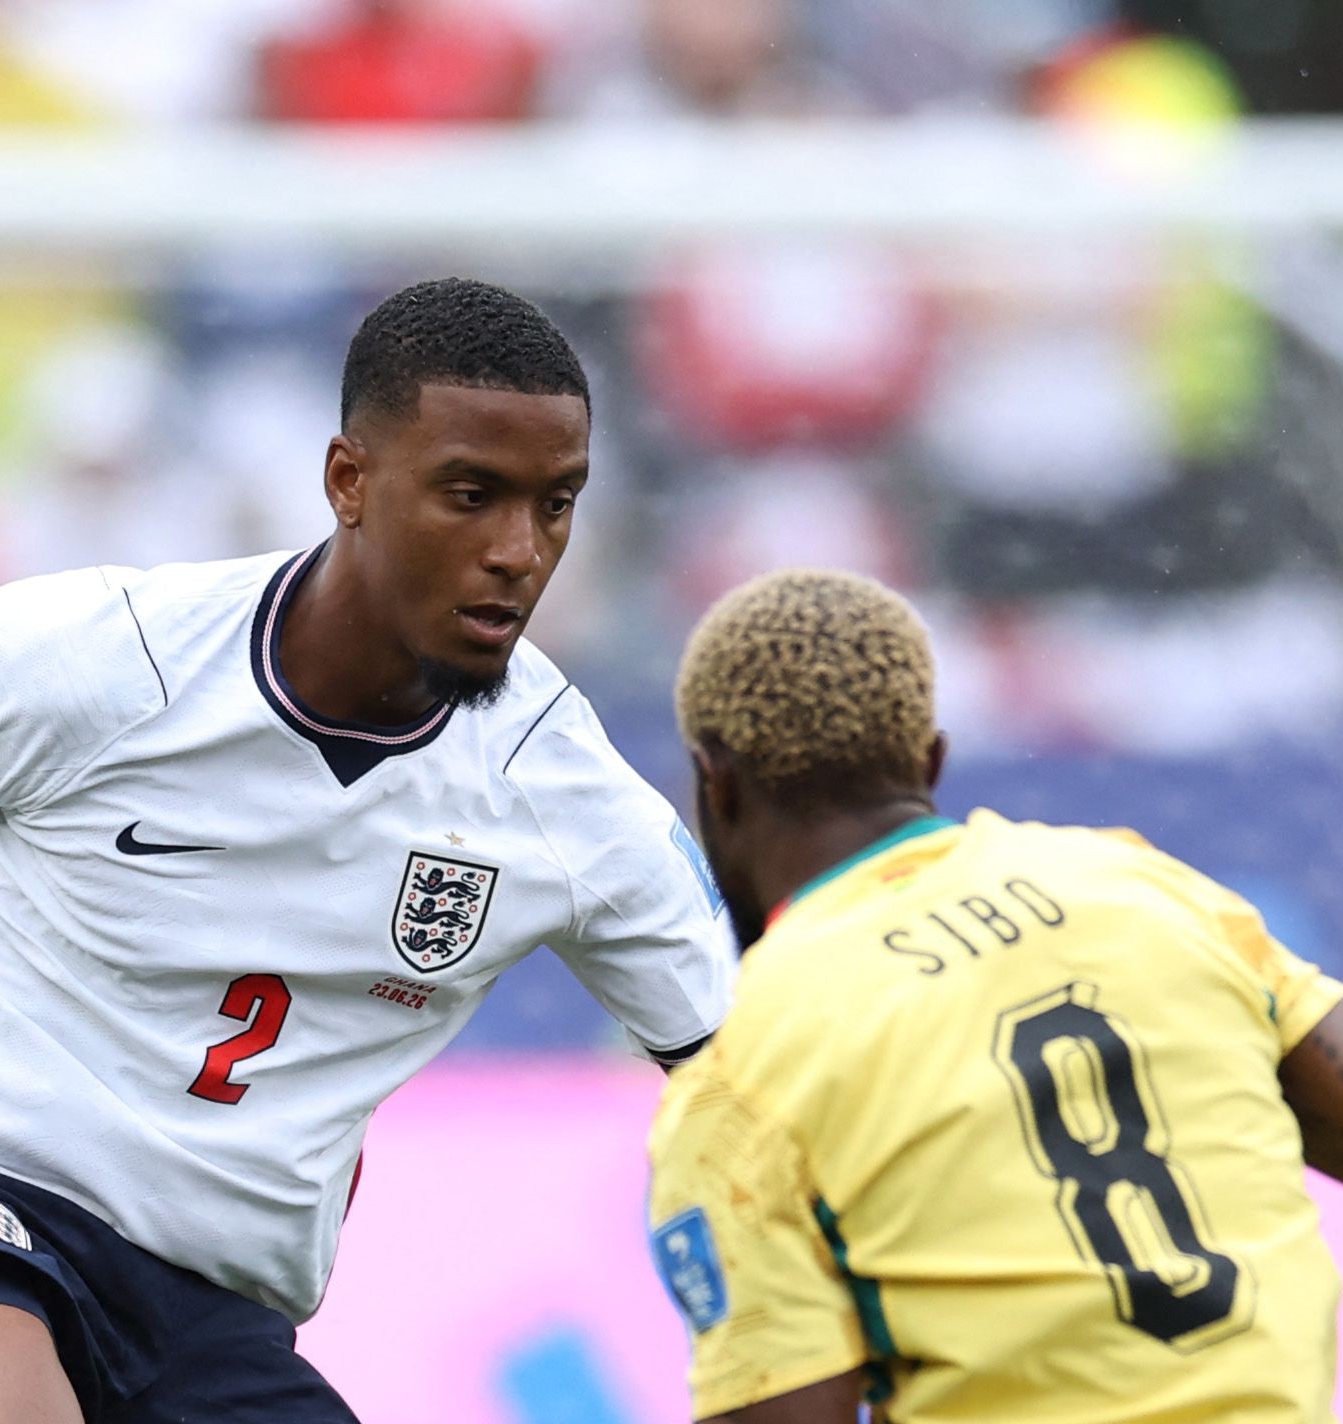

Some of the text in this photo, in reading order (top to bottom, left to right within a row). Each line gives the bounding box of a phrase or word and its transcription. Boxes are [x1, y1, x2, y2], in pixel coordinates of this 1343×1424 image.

[883, 879, 1065, 975] SIBO
[368, 983, 427, 1010] 23.06.26
[383, 976, 437, 994] GHANA
[187, 973, 292, 1105] 2
[993, 981, 1257, 1355] 8
